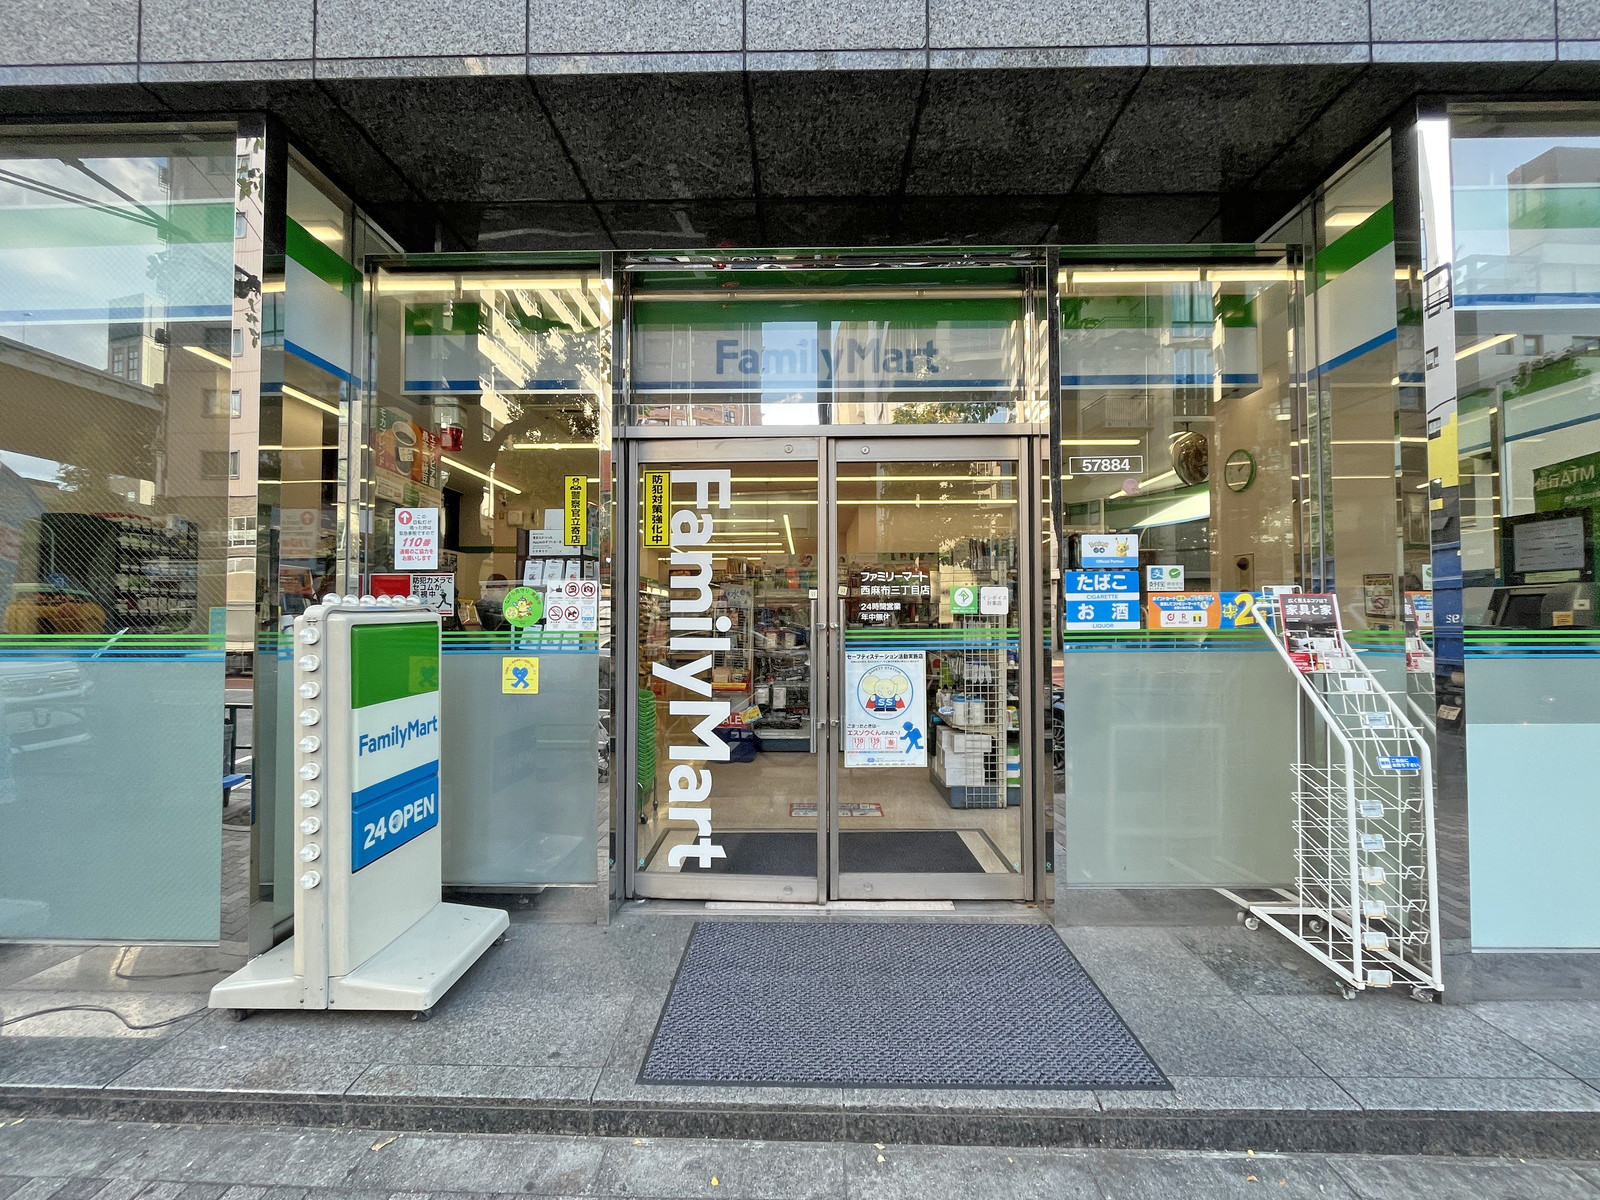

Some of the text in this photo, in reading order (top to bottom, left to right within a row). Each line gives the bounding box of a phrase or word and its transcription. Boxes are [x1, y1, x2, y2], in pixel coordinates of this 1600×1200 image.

[716, 338, 939, 380] FamilyMart
[1082, 459, 1130, 471] 57884
[652, 475, 663, 544] 防犯対策強化中
[571, 491, 581, 544] 警察官立寄店
[402, 537, 431, 547] 110番
[860, 572, 928, 582] ファミリーマート
[1077, 574, 1128, 590] たばこ
[860, 586, 930, 595] 西麻布三丁目店
[1285, 604, 1332, 615] 家具と家
[652, 469, 732, 868] FamilyMart
[722, 715, 742, 724] ALE
[358, 716, 438, 756] FamilyMart
